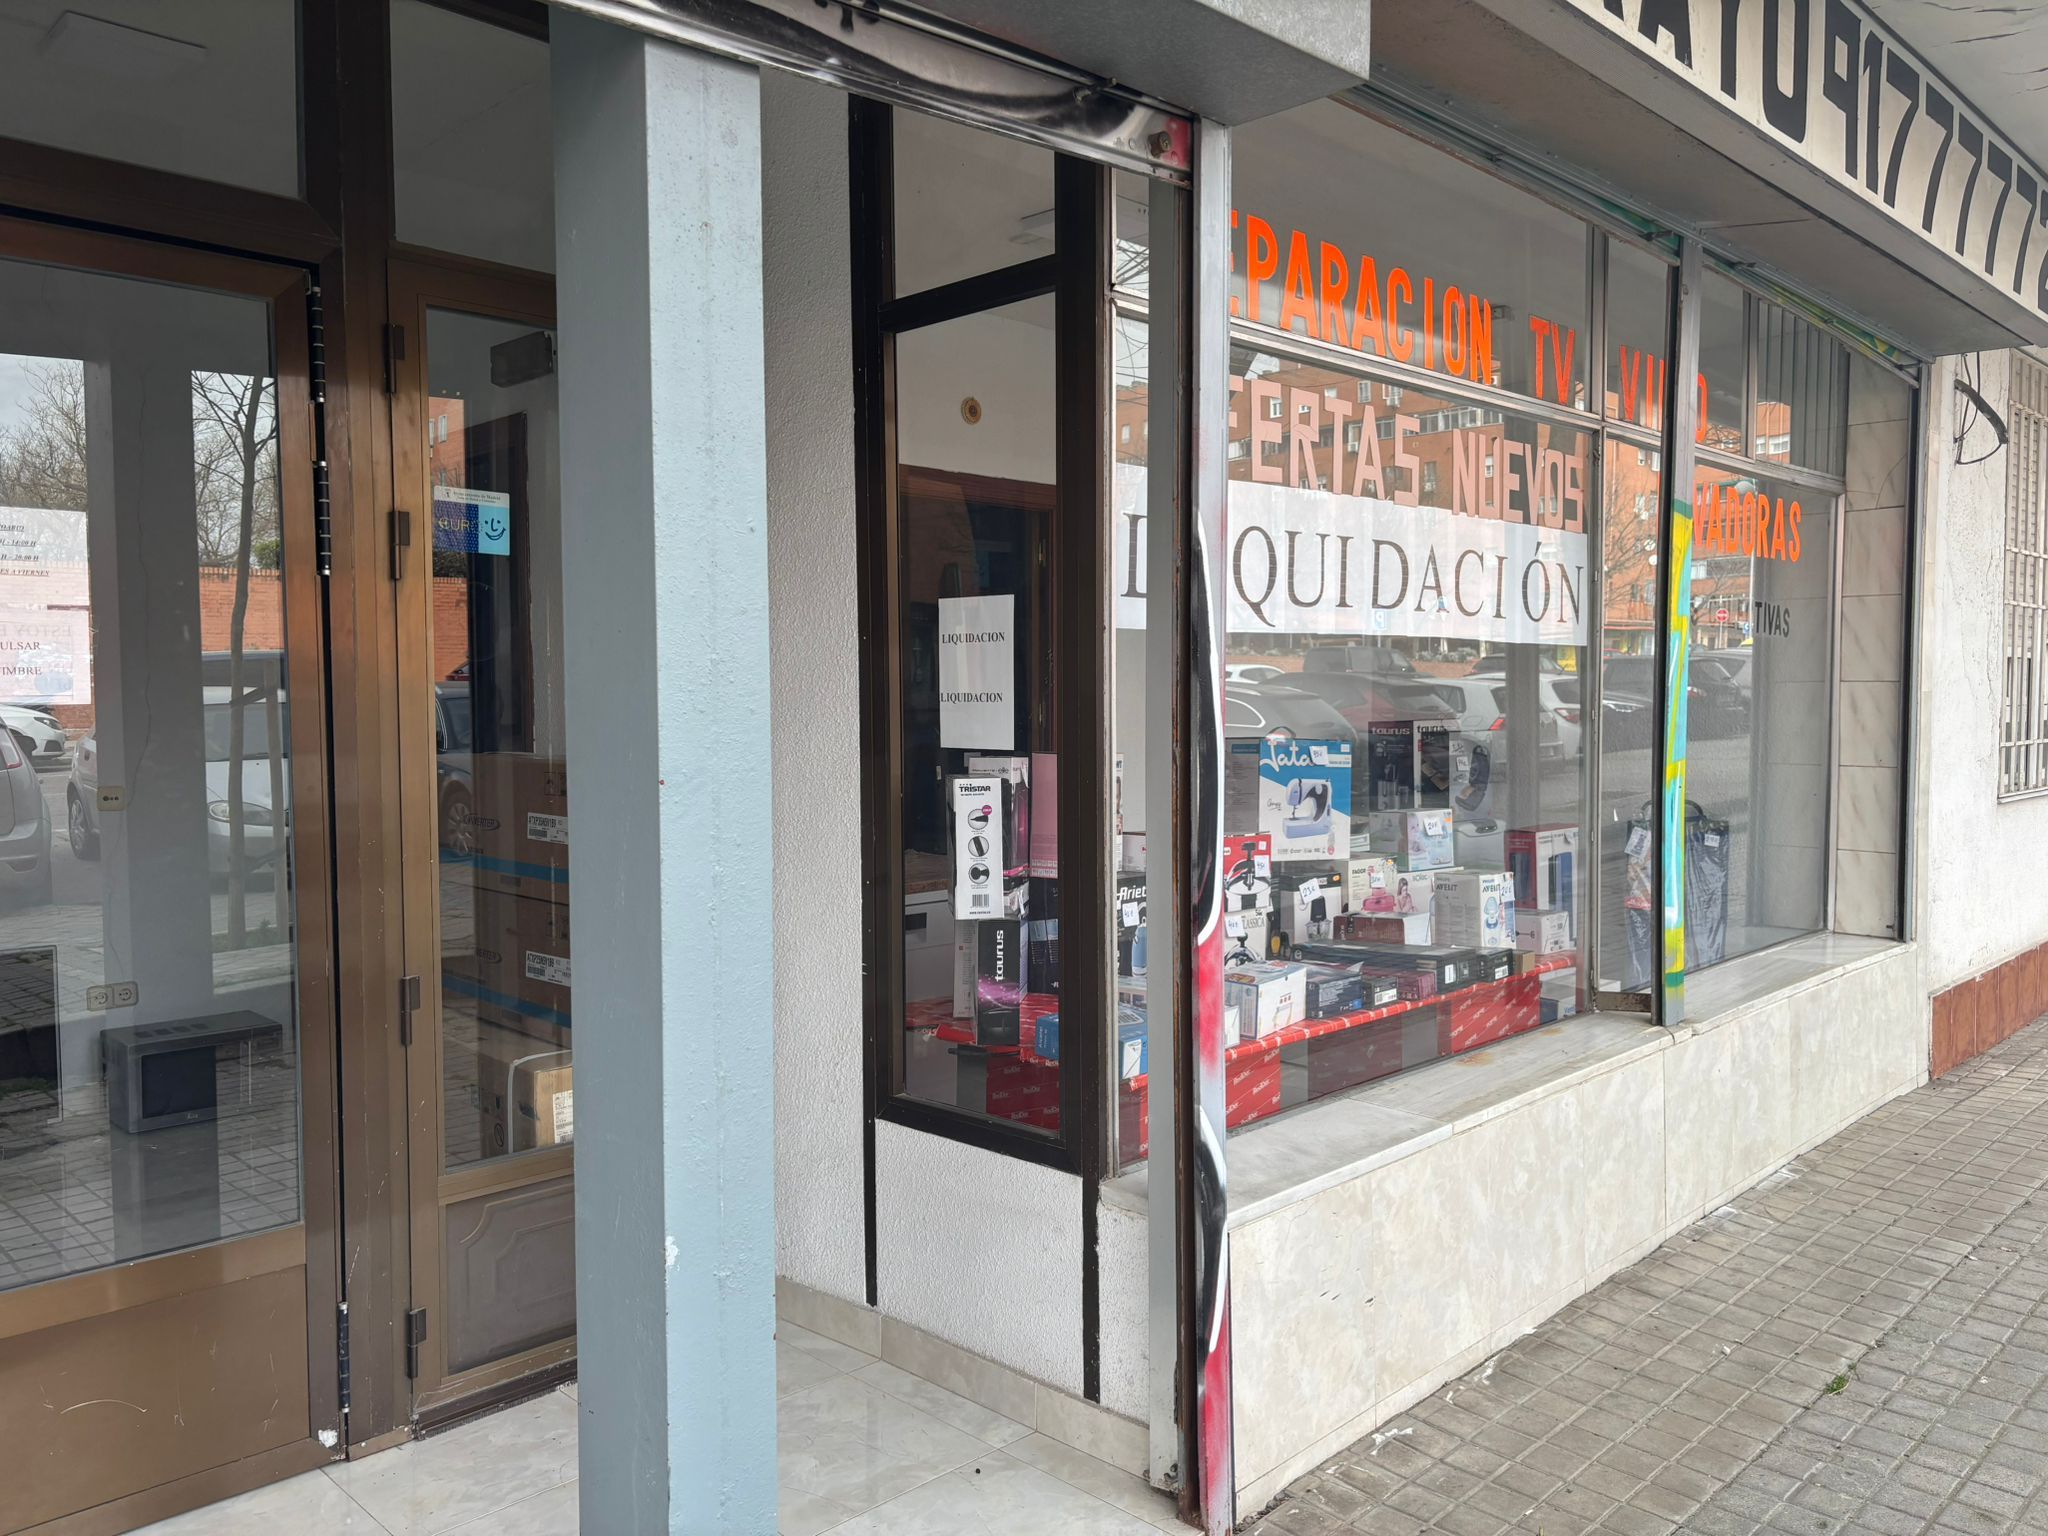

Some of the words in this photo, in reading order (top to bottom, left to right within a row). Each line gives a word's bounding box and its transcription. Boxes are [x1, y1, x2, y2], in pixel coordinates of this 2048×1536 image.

[1529, 315, 1575, 405] TV
[1452, 428, 1584, 533] NUEVOS
[1121, 512, 1584, 627] LQUIDACIÓN
[942, 631, 1005, 645] LIQUIDACION
[1754, 601, 1791, 638] TIVAS
[940, 692, 1003, 704] LIQUIDACION
[1371, 726, 1411, 735] taurus
[1259, 739, 1316, 772] Jata
[995, 929, 1004, 982] taurus
